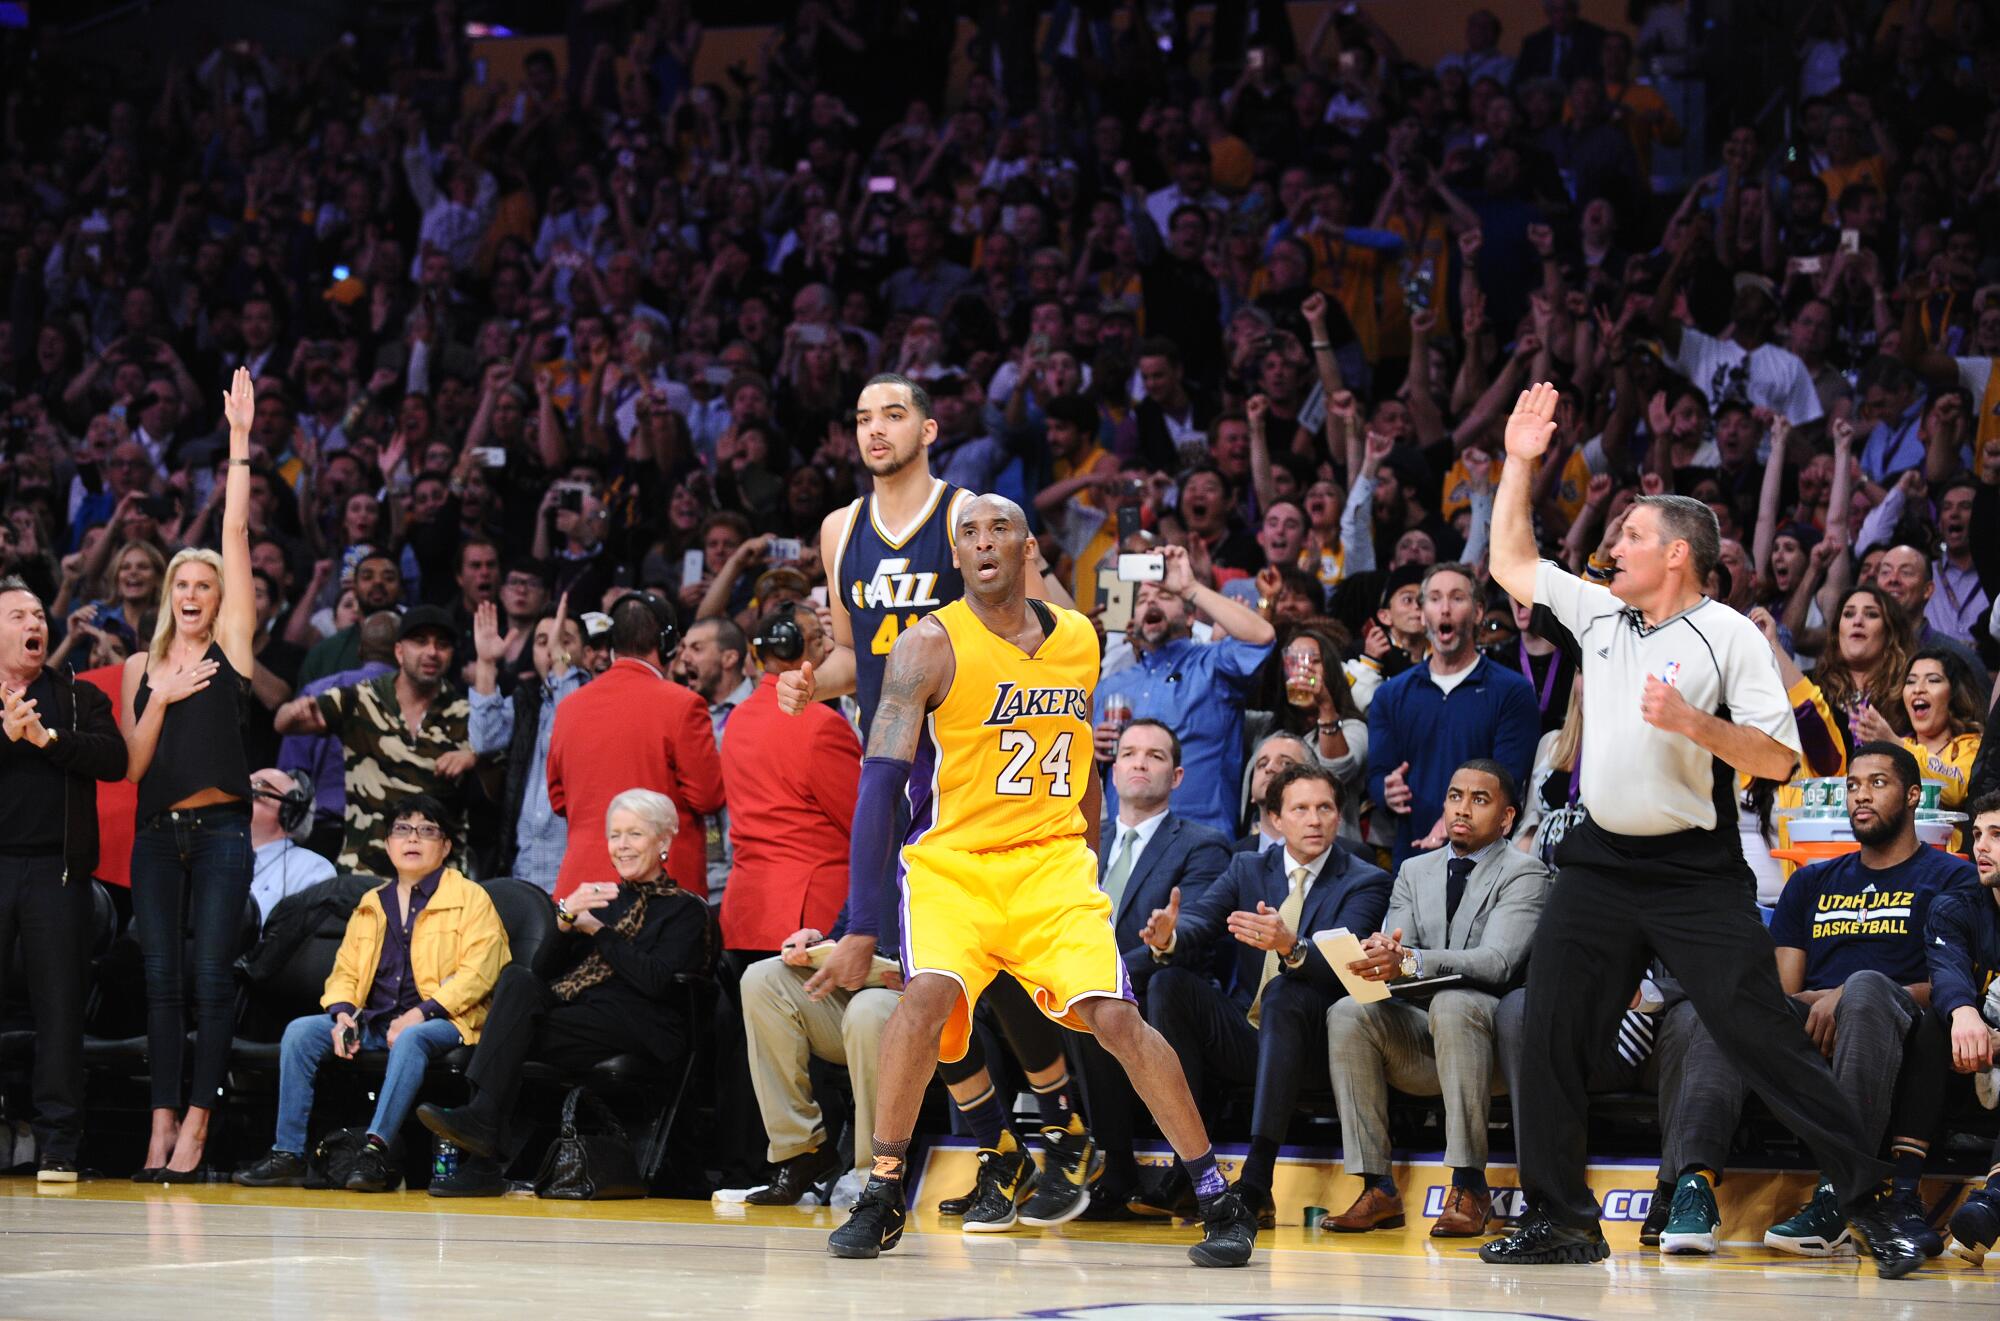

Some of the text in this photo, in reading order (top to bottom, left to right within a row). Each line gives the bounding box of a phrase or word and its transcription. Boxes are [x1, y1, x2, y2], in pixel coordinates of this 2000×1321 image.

[852, 558, 940, 609] JAZZ
[871, 613, 919, 655] 4
[982, 681, 1087, 726] LAKERS
[996, 729, 1074, 797] 24
[1817, 891, 1915, 912] UTAH JAZZ
[1812, 919, 1908, 939] BASKETBALL
